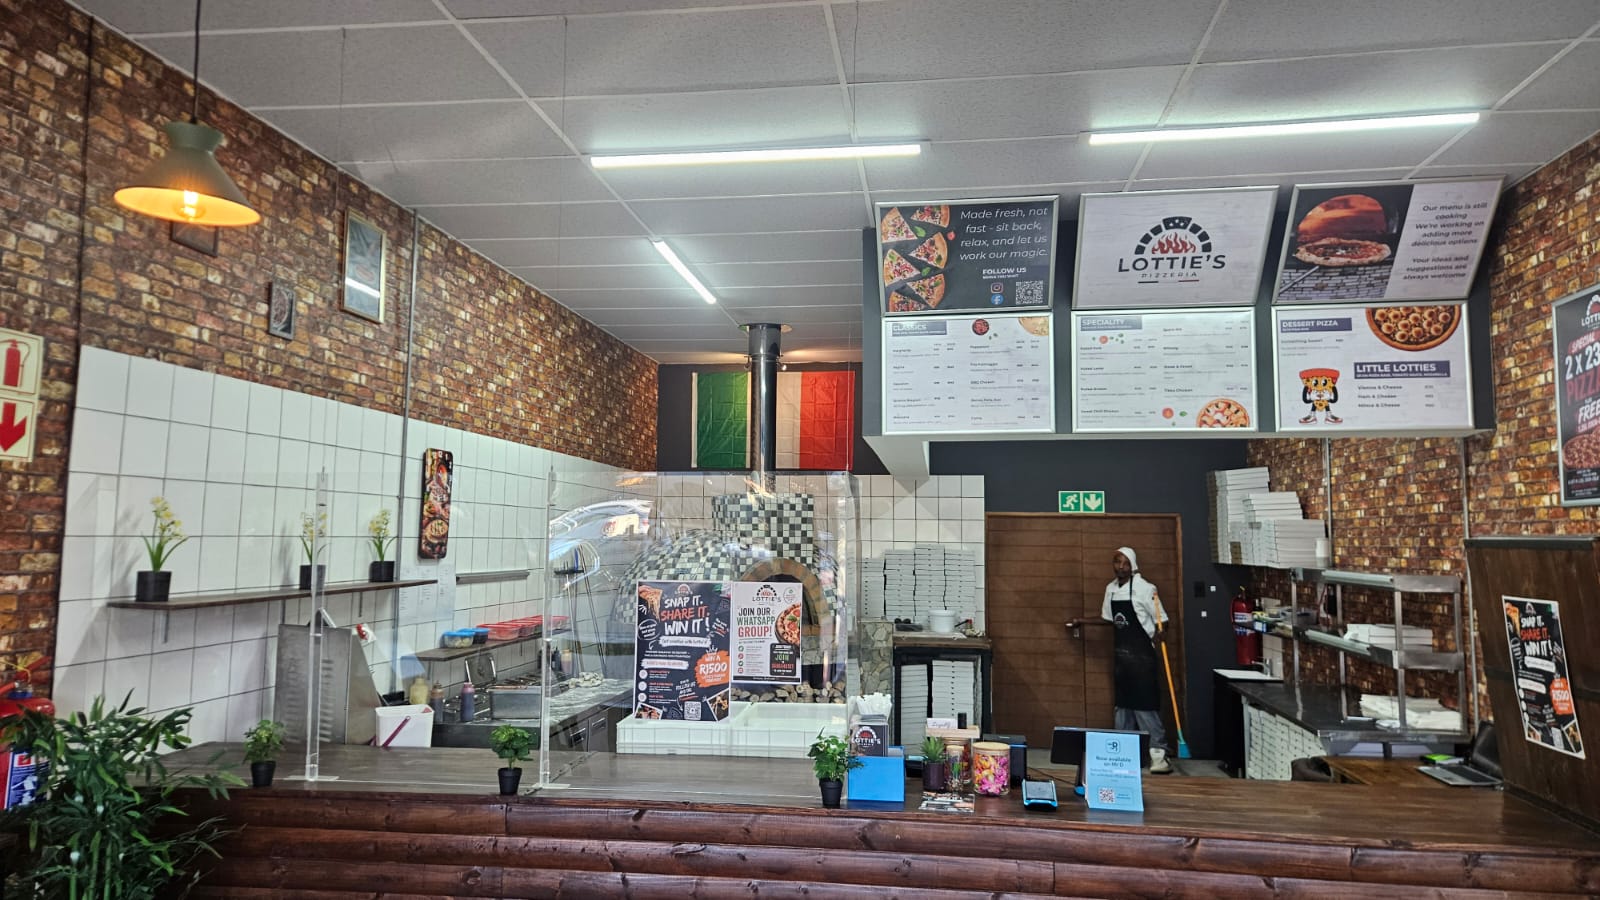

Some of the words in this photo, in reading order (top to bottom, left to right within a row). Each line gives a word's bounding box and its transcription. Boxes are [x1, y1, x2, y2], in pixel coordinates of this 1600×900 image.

[960, 210, 992, 220] Made
[994, 208, 1026, 219] fresh,
[1028, 208, 1048, 216] not
[1435, 212, 1468, 220] cooking
[965, 224, 986, 234] fast
[996, 222, 1009, 232] sit
[1012, 221, 1042, 232] back,
[1440, 221, 1472, 229] working
[960, 238, 990, 248] relax,
[992, 236, 1014, 246] and
[1017, 235, 1032, 245] let
[1448, 238, 1478, 246] options
[960, 251, 986, 261] work
[988, 252, 1007, 260] our
[1009, 248, 1048, 260] magic.
[1118, 254, 1226, 272] LOTTIE'S
[982, 268, 1015, 276] FOLLOW
[1016, 266, 1027, 274] US
[1282, 320, 1315, 328] DESSERT
[1356, 364, 1391, 373] LITTLE
[1393, 363, 1437, 372] LOTTIES
[1565, 355, 1574, 381] 2
[664, 596, 690, 608] SNAP
[692, 594, 704, 606] IT.
[660, 608, 695, 622] SHARE
[698, 606, 710, 618] IT.
[738, 608, 754, 616] JOIN
[756, 608, 771, 616] OUR
[736, 616, 776, 626] WHATSAPP
[664, 620, 688, 636] WIN
[738, 626, 772, 638] GROUP!
